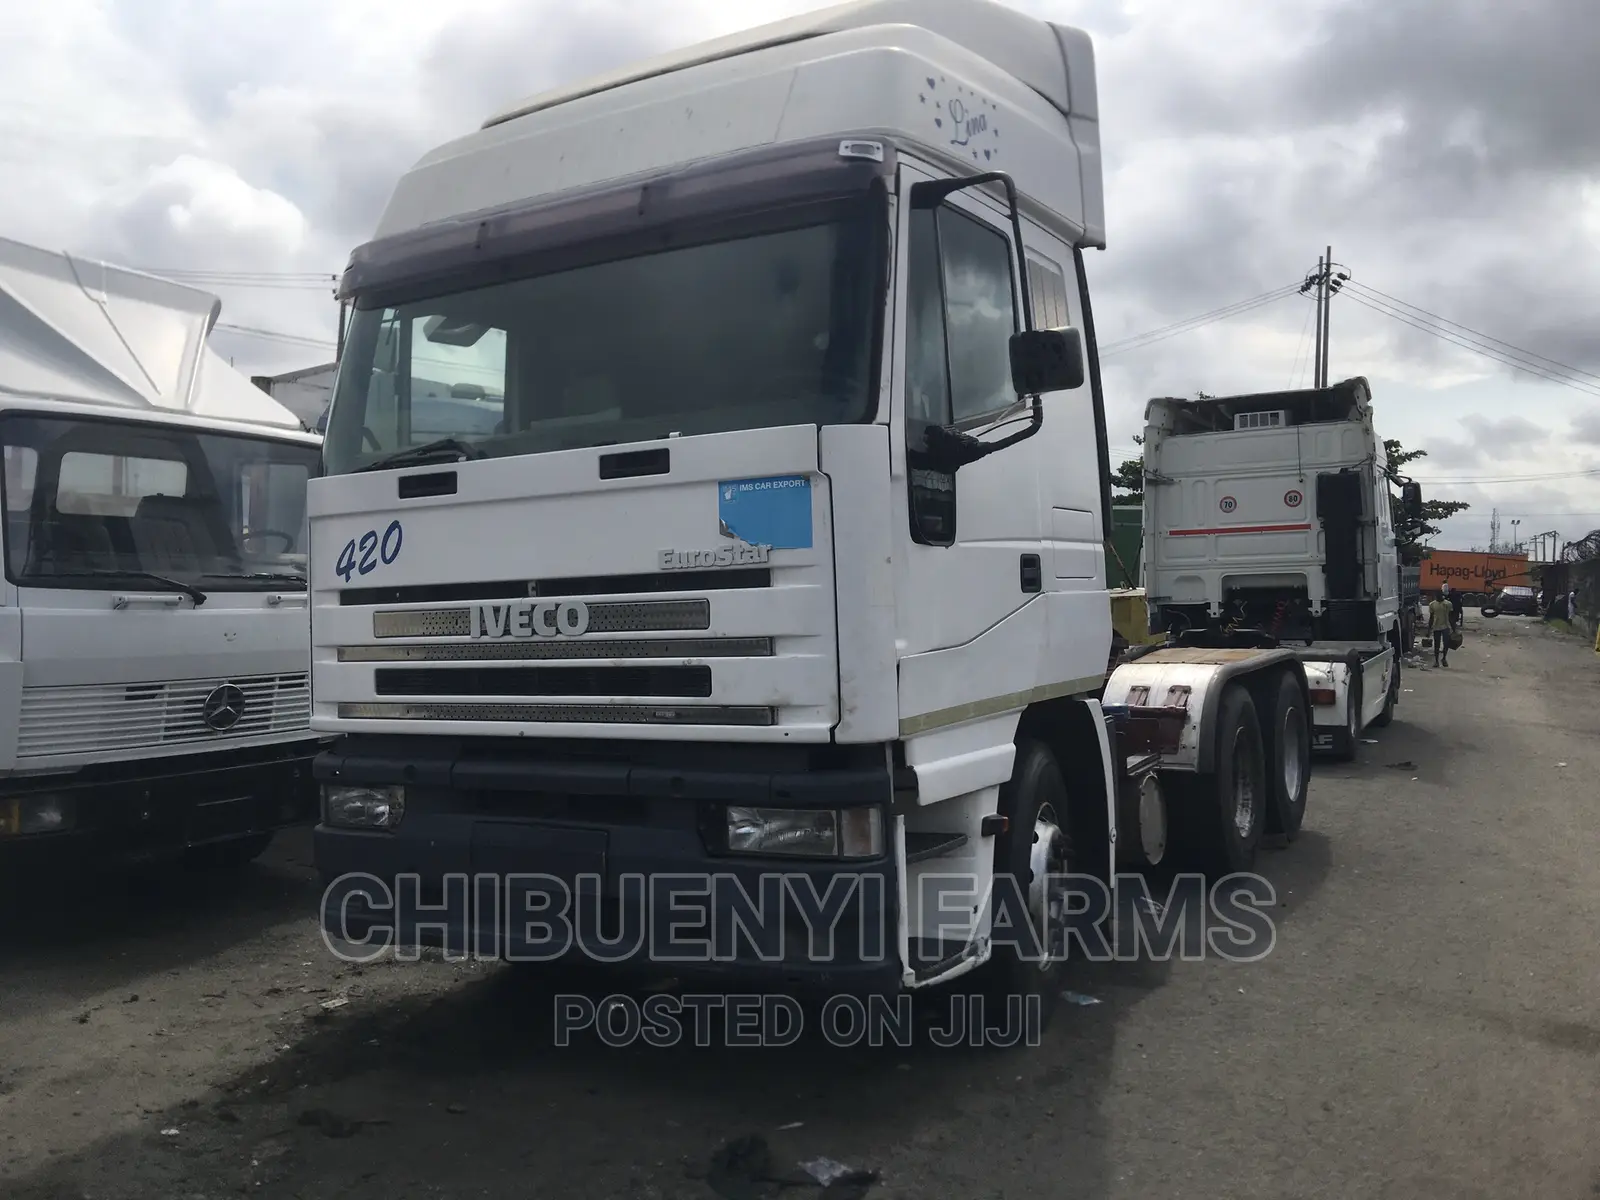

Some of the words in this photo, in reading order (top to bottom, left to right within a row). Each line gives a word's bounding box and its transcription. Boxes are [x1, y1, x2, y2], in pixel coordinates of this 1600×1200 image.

[739, 484, 754, 492] IMS
[754, 482, 772, 491] CAR
[773, 479, 805, 489] EXPORT
[1224, 501, 1233, 509] 70
[1288, 495, 1298, 503] 80
[335, 520, 403, 583] 420
[658, 544, 772, 570] EuroStar
[469, 601, 589, 639] IVECO
